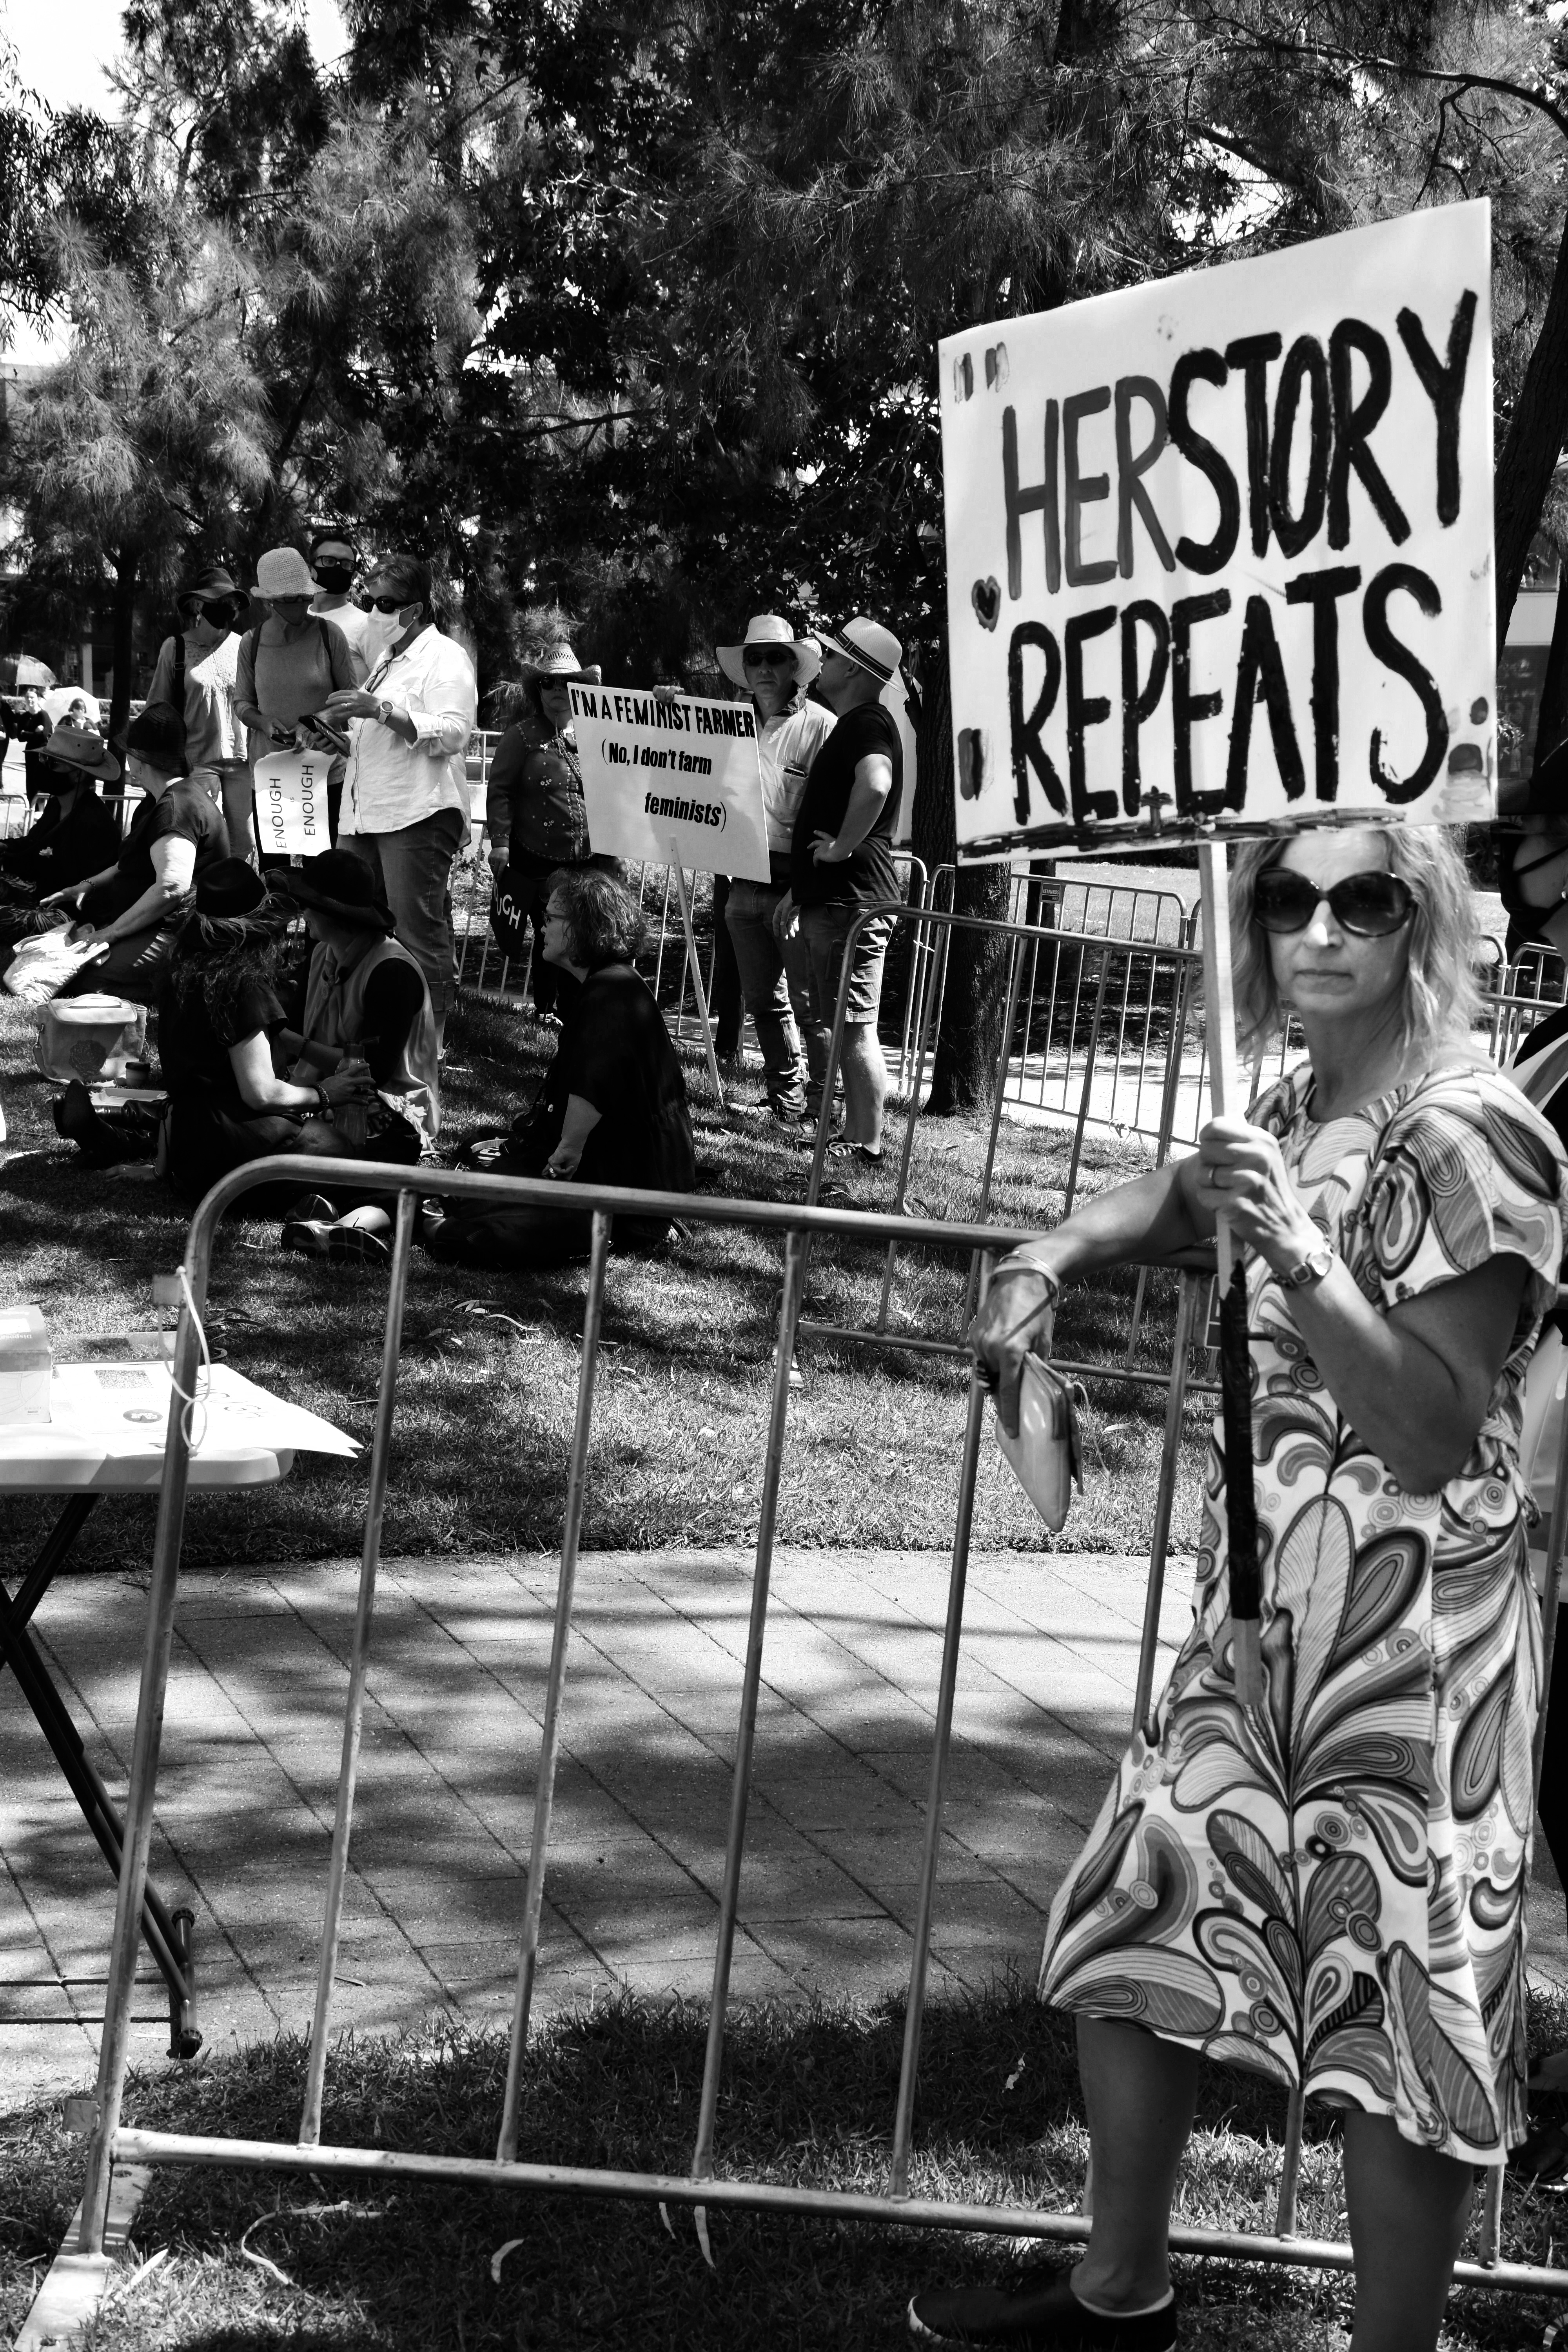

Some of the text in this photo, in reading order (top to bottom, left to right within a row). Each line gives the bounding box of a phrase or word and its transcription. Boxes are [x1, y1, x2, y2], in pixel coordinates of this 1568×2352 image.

[1003, 287, 1478, 601] HERSTORY
[570, 689, 755, 738] I'M A FEMINIST FARMER
[1007, 563, 1449, 826] REPEATS
[633, 745, 639, 765] I
[641, 747, 677, 770] don't
[679, 751, 712, 775] farm
[269, 778, 287, 848] ENOUGH
[301, 765, 316, 836] ENOUGH
[644, 793, 727, 832] feminists)
